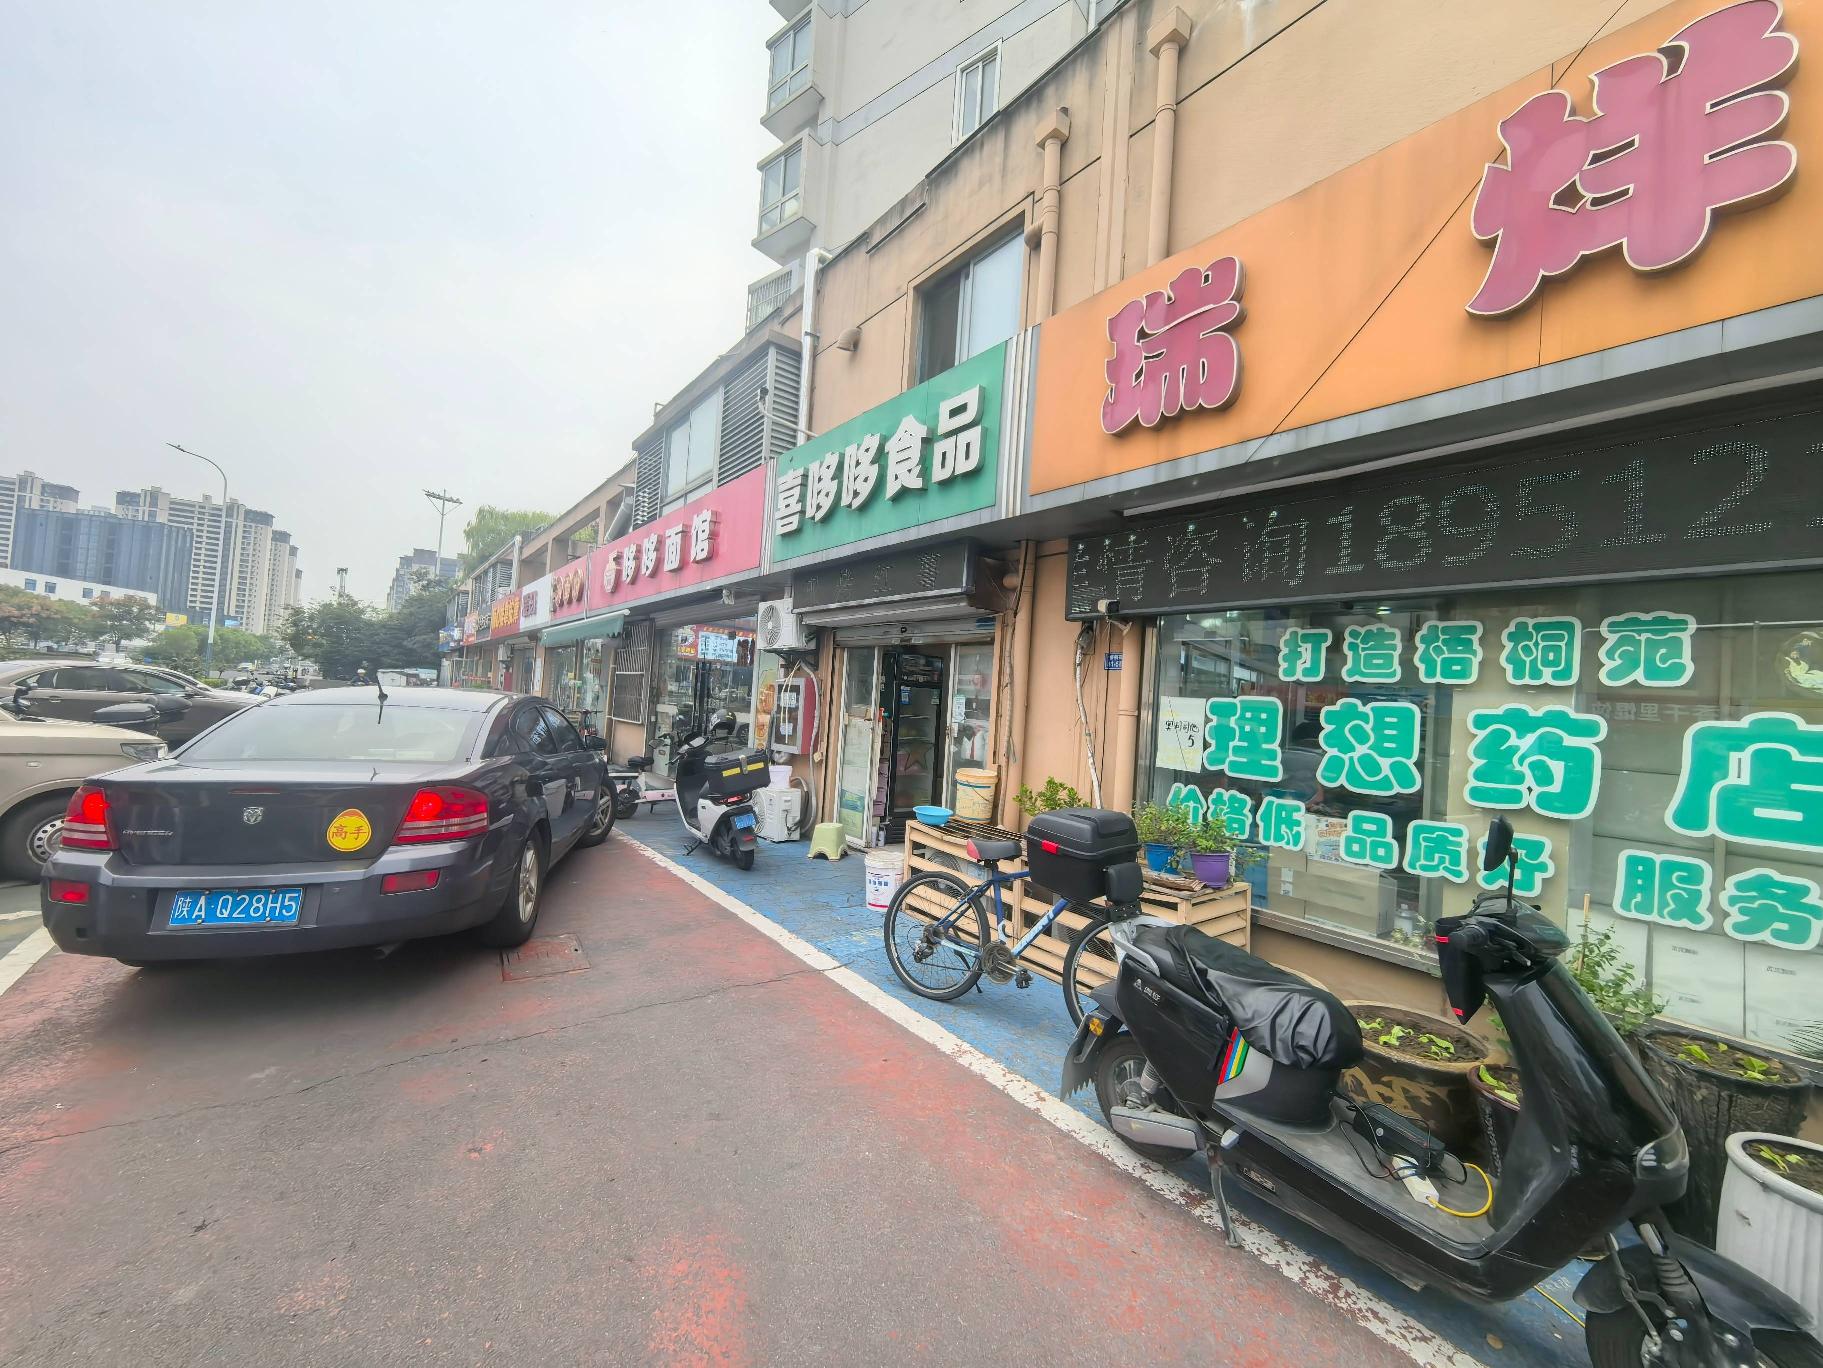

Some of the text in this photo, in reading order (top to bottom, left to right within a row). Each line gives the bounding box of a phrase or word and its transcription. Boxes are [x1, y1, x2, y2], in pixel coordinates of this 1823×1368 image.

[776, 384, 984, 536] 喜哆哆食品
[1278, 612, 1696, 688] 打造梧桐苑
[331, 824, 368, 841] 高手
[1203, 696, 1823, 852] 理想药店
[1167, 782, 1823, 951] 价格低 品质好 服务
